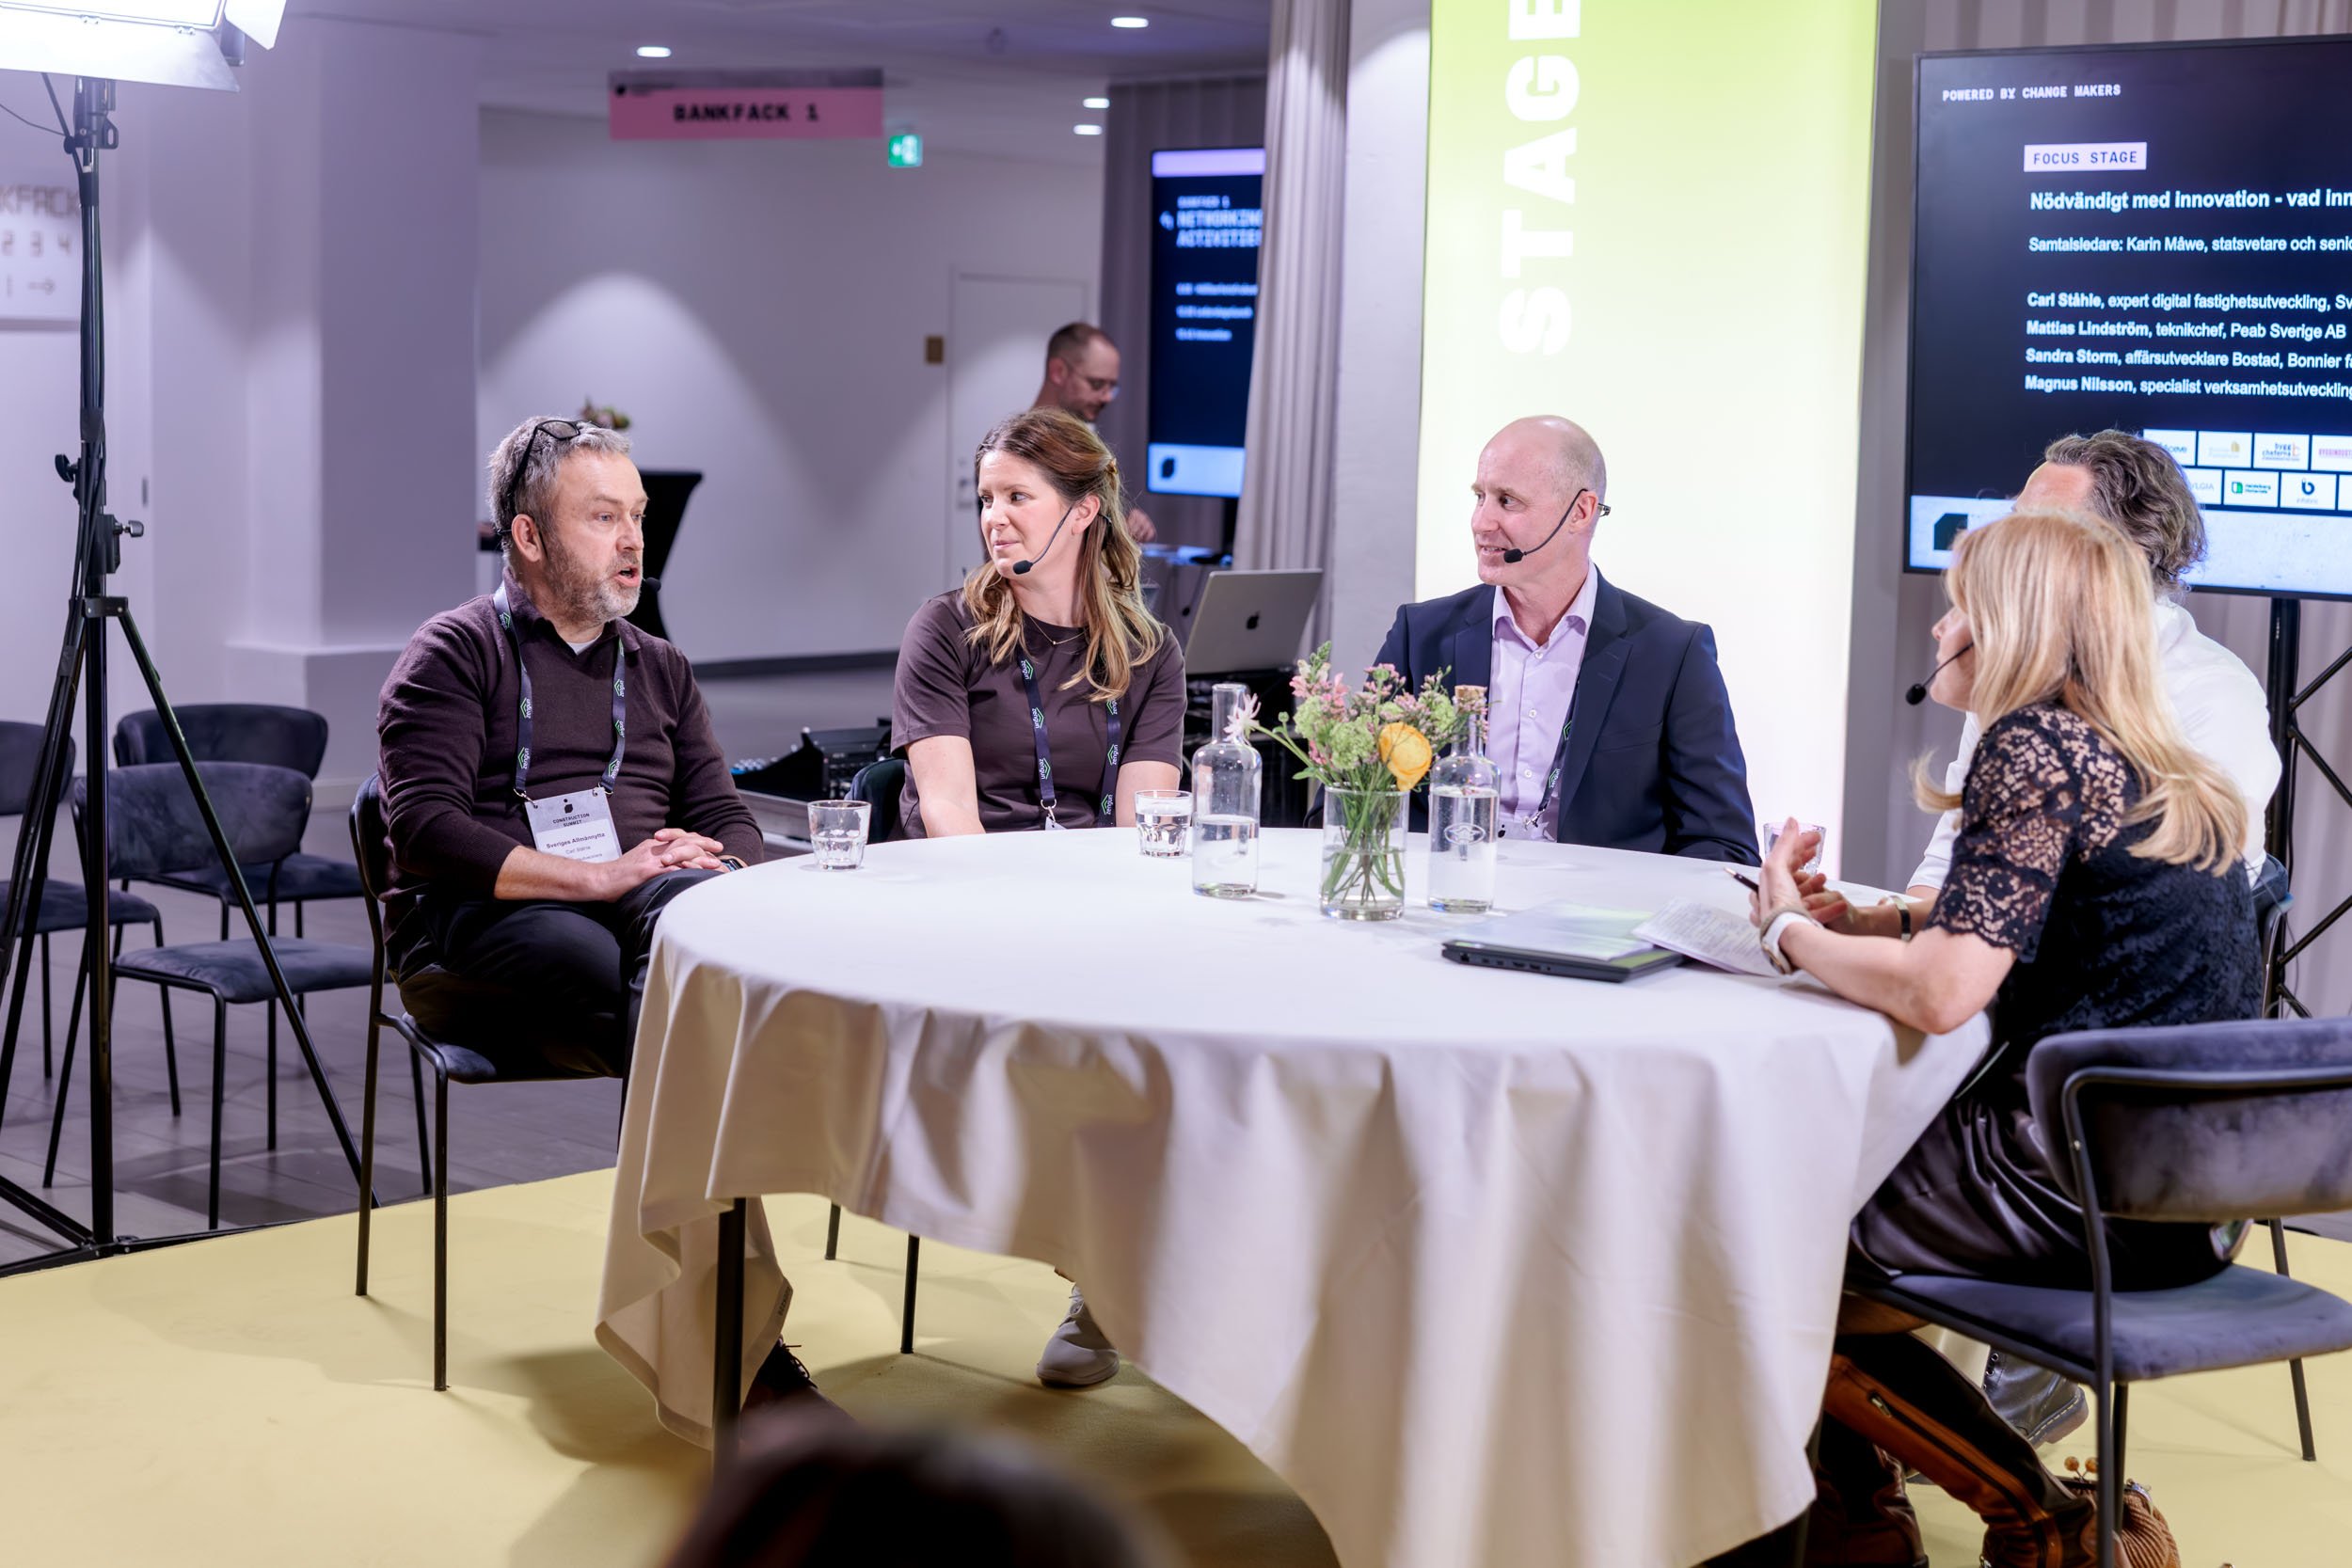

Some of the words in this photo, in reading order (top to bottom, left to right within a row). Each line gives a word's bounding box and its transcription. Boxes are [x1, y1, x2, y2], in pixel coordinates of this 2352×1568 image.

[1942, 88, 1994, 102] POWERED
[2000, 87, 2015, 100] BY
[2023, 86, 2067, 99] CHANGE
[2074, 84, 2121, 97] MAKERS
[673, 103, 789, 122] BANKFACK
[2033, 151, 2079, 165] FOCUS
[2090, 150, 2137, 164] STAGE
[1499, 0, 1581, 356] STAGE
[2030, 191, 2129, 213] Nödvändigt
[2132, 190, 2170, 209] med
[2174, 189, 2270, 208] innovation
[2286, 188, 2321, 207] vad
[2028, 236, 2123, 252] Samtalsledare:
[2126, 236, 2161, 252] Karin
[2164, 235, 2208, 253] Måwe,
[2212, 236, 2287, 252] statsvetare
[2290, 235, 2316, 251] och
[2027, 292, 2056, 308] Carl
[2058, 292, 2105, 309] Ståhle,
[2107, 294, 2150, 310] expert
[2152, 293, 2191, 311] digital
[2194, 293, 2330, 312] fastighetsutveckling,
[2026, 320, 2075, 336] Mattias
[2078, 321, 2153, 339] Lindström,
[2155, 322, 2227, 340] teknikchef,
[2231, 323, 2266, 338] Peab
[2269, 323, 2322, 341] Sverige
[2325, 324, 2346, 339] AB
[2026, 347, 2074, 363] Sandra
[2076, 348, 2122, 366] Storm,
[2124, 350, 2229, 366] affärsutvecklare
[2232, 352, 2283, 370] Bostad,
[2287, 353, 2342, 369] Bonnier
[2025, 374, 2078, 393] Magnus
[2081, 376, 2137, 394] Nilsson,
[2139, 378, 2201, 396] specialist
[552, 813, 590, 824] CONSTRUCTION
[546, 840, 571, 849] Sveriges
